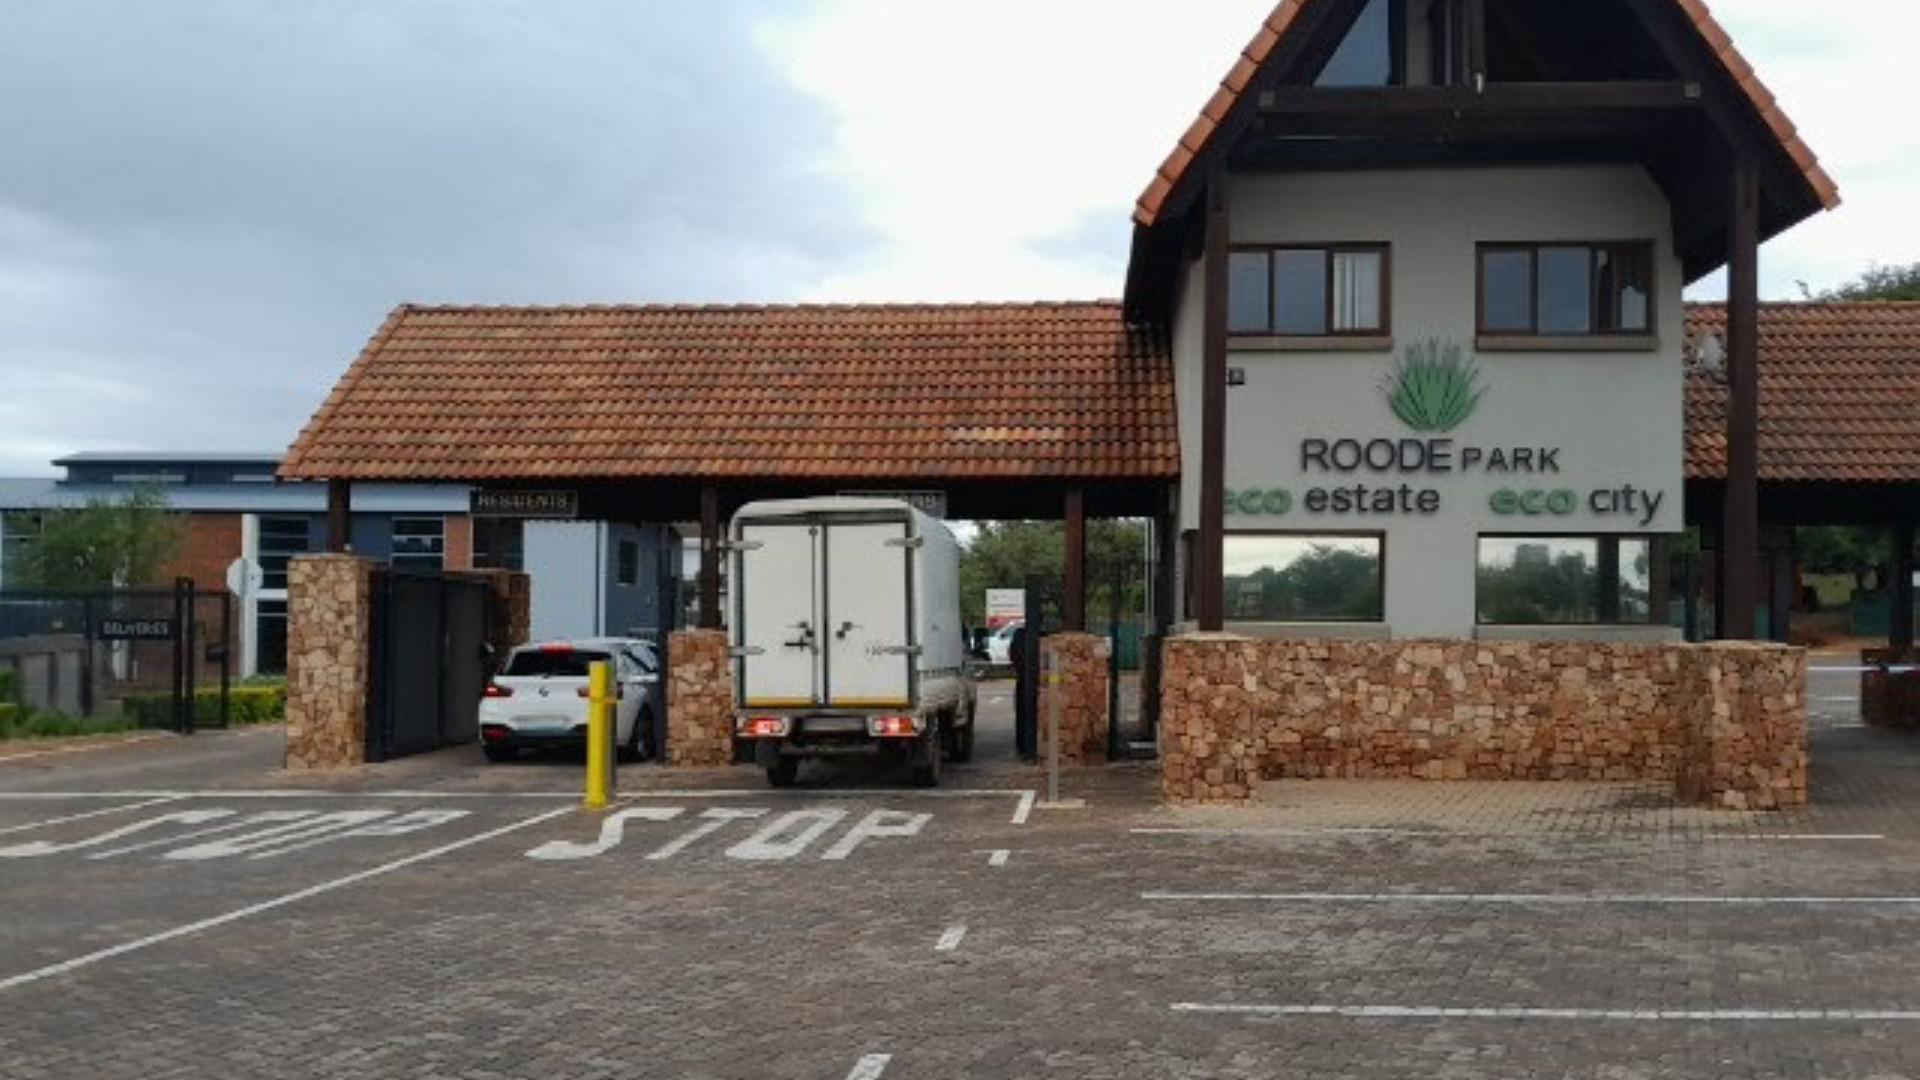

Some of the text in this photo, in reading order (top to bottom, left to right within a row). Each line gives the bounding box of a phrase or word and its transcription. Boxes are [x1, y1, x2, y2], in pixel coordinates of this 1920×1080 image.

[1301, 438, 1560, 472] ROODE PARK
[1303, 483, 1440, 513] estate
[1488, 483, 1664, 526] eco city
[0, 809, 472, 859] STOP
[524, 807, 933, 860] STOP
